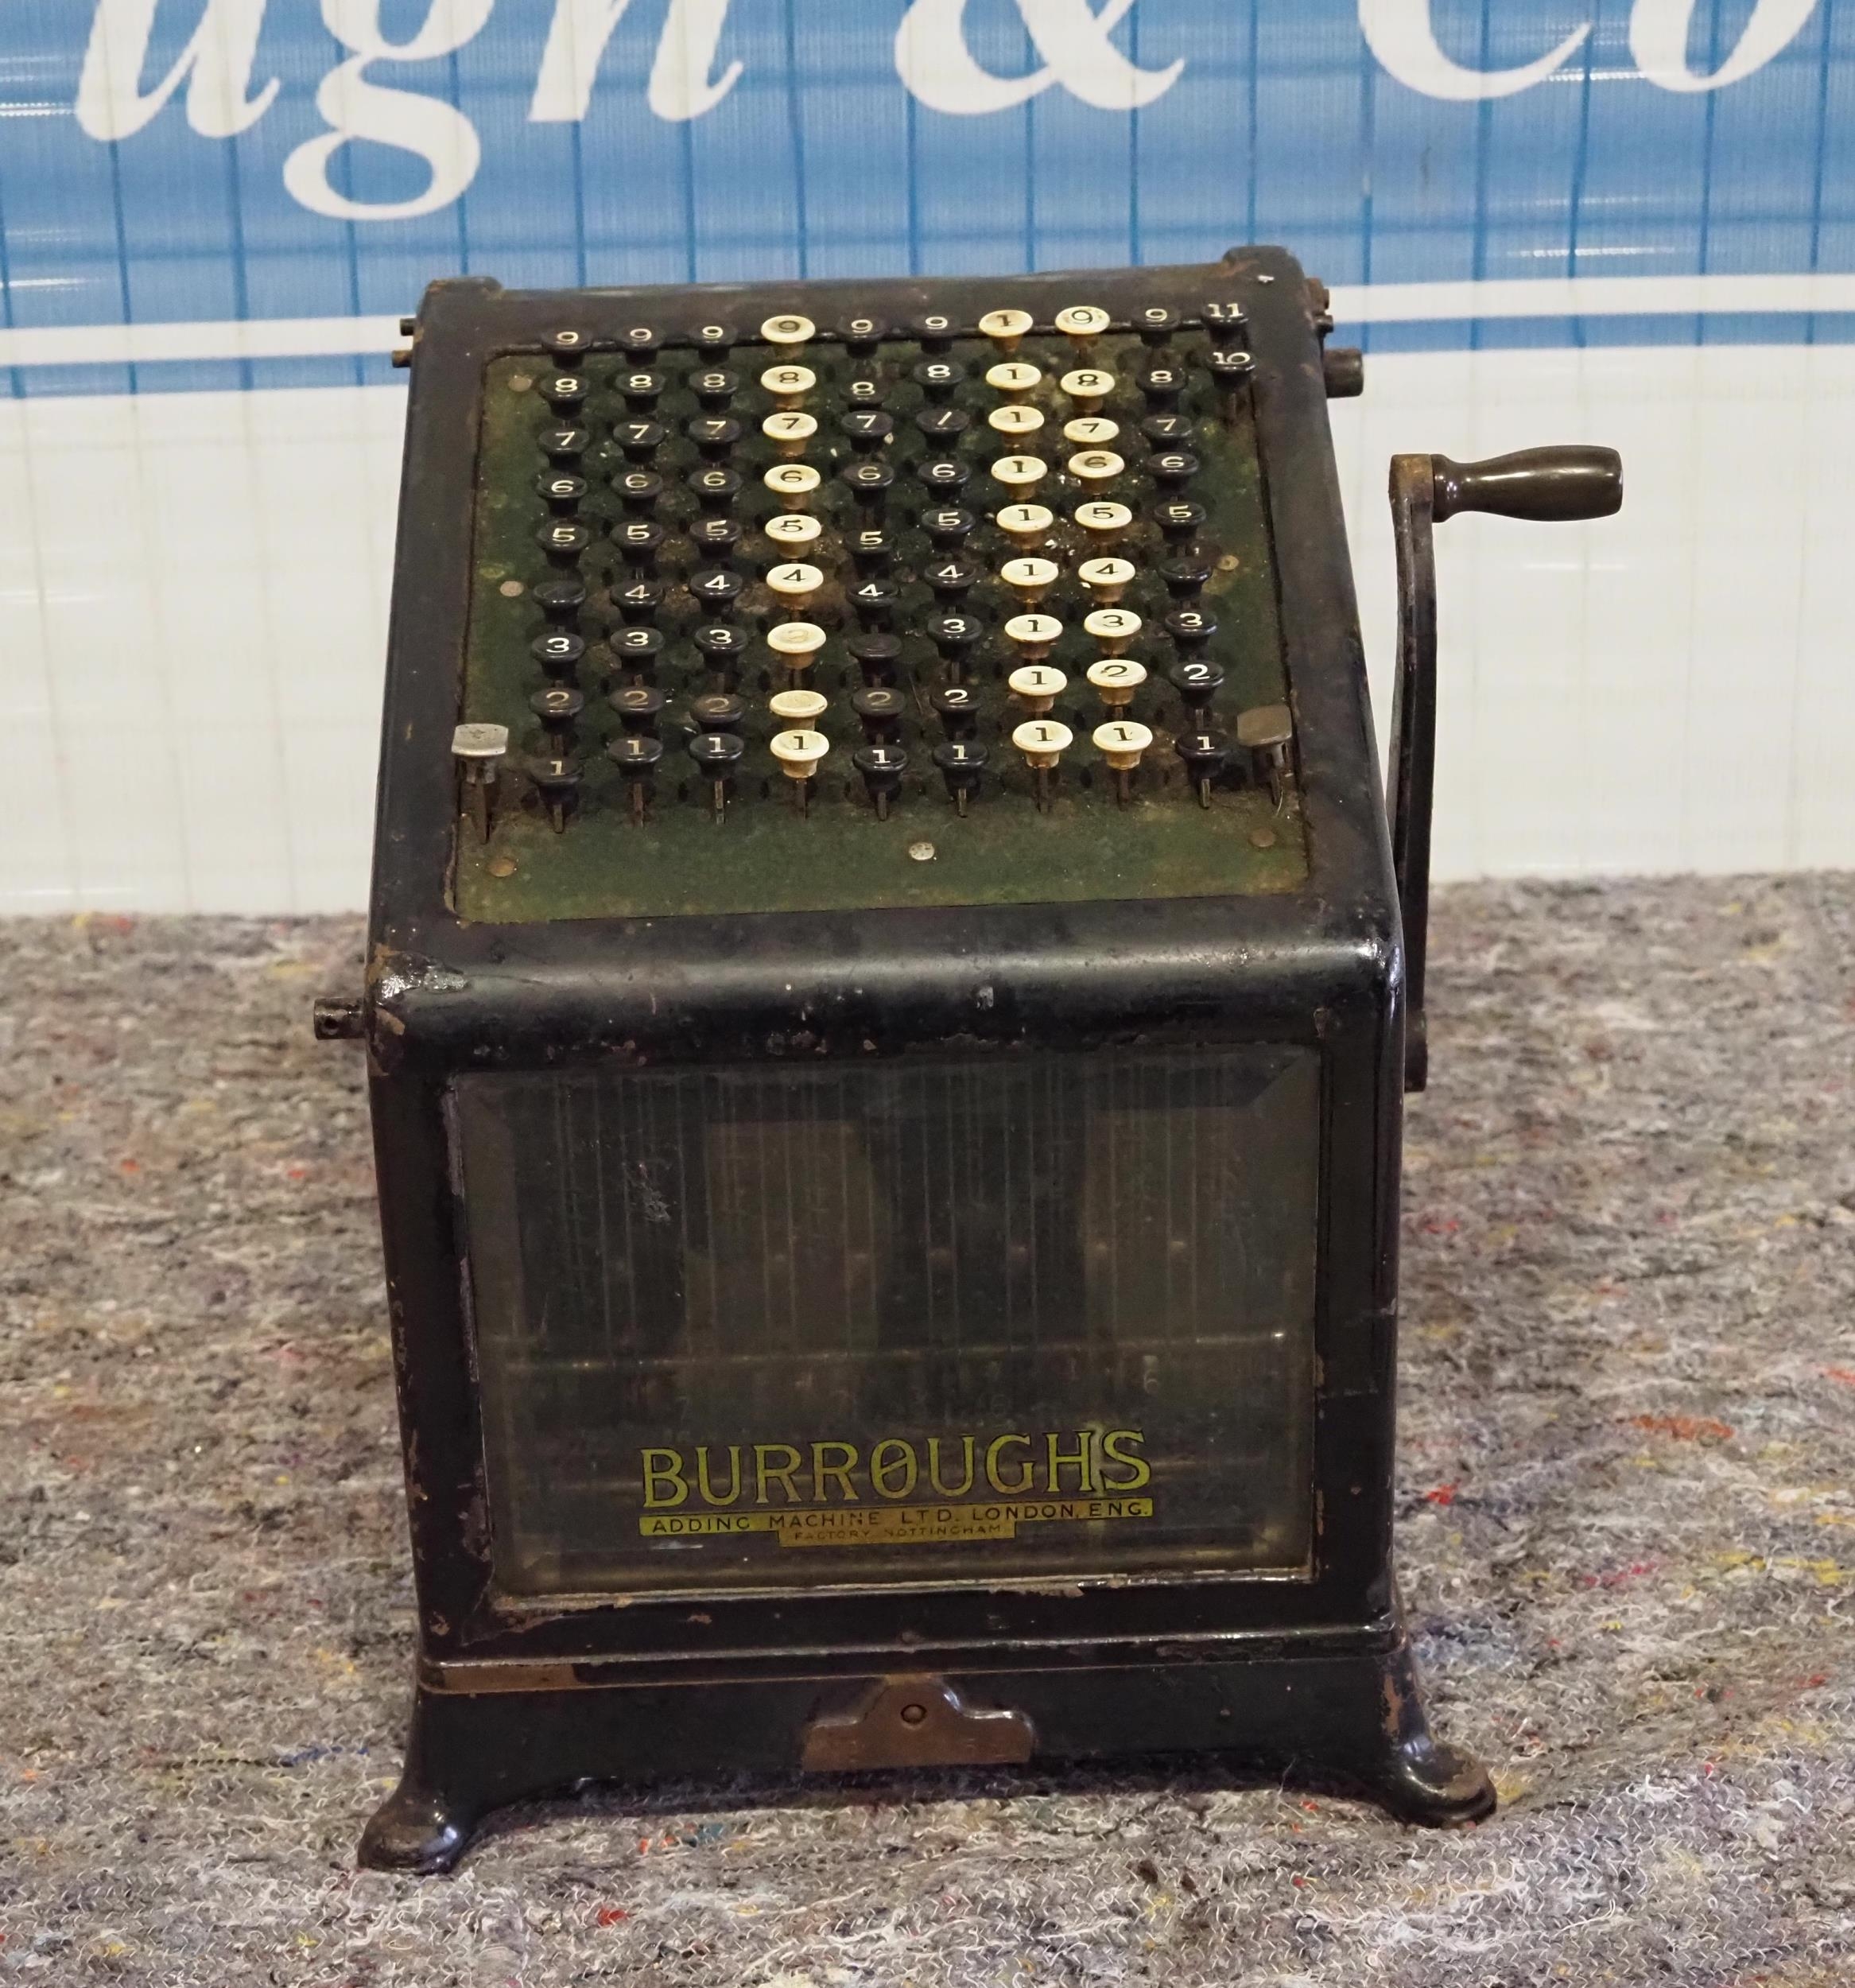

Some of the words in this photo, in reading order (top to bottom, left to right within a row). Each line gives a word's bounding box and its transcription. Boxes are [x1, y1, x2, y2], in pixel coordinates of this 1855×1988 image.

[557, 331, 579, 344] 9
[629, 328, 653, 342] 9
[701, 325, 724, 340] 9
[850, 318, 874, 333] 9
[925, 316, 949, 330] 9
[995, 313, 1012, 327] 1
[1071, 309, 1093, 325] 9
[1145, 308, 1168, 322] 9
[1206, 303, 1244, 318] 11
[555, 378, 578, 393] 8
[629, 374, 653, 388] 8
[703, 373, 726, 388] 8
[778, 371, 800, 385] 8
[852, 381, 875, 396] 8
[926, 364, 951, 379] 8
[1006, 367, 1019, 380] 1
[1077, 373, 1099, 387] 8
[1150, 369, 1173, 384] 8
[1212, 351, 1251, 365] 10
[555, 431, 576, 446] 7
[629, 424, 650, 439] 7
[706, 420, 727, 435] 7
[782, 417, 801, 430] 7
[856, 414, 877, 429] 7
[1009, 411, 1024, 423] 1
[1081, 422, 1100, 433] 7
[1156, 417, 1177, 432] 7
[551, 480, 575, 493] 6
[625, 473, 650, 489] 6
[703, 471, 726, 487] 6
[779, 469, 803, 483] 6
[857, 466, 882, 481] 6
[932, 463, 956, 478] 6
[1011, 460, 1027, 474] 1
[1084, 456, 1108, 469] 6
[1160, 456, 1185, 468] 6
[552, 527, 576, 542] 5
[627, 524, 650, 540] 5
[706, 519, 728, 537] 5
[779, 518, 803, 534] 5
[859, 530, 883, 546] 5
[937, 511, 961, 526] 5
[1017, 508, 1035, 522] 1
[1092, 507, 1114, 520] 5
[1168, 504, 1193, 519] 5
[624, 584, 650, 600] 4
[704, 574, 731, 591] 4
[782, 569, 806, 582] 4
[858, 583, 884, 597] 4
[937, 564, 964, 579] 4
[1023, 563, 1038, 577] 1
[1095, 562, 1119, 576] 4
[545, 637, 570, 654] 3
[625, 631, 649, 646] 3
[709, 629, 732, 645] 3
[942, 618, 966, 634] 3
[1026, 619, 1042, 633] 1
[1102, 614, 1124, 628] 3
[1178, 612, 1204, 628] 3
[545, 691, 570, 708] 2
[623, 690, 649, 706] 2
[704, 697, 730, 712] 2
[867, 691, 891, 706] 2
[944, 689, 969, 704] 2
[1030, 670, 1048, 685] 1
[1099, 664, 1130, 678] 2
[1183, 663, 1210, 681] 2
[549, 760, 564, 776] 1
[626, 739, 645, 755] 1
[708, 736, 726, 753] 1
[793, 735, 809, 751] 1
[871, 749, 891, 764] 1
[952, 744, 969, 760] 1
[1034, 726, 1054, 742] 1
[1112, 727, 1134, 742] 1
[1196, 735, 1216, 751] 1
[640, 1430, 1151, 1508] BURROUGHS
[652, 1516, 751, 1534] ADDING
[768, 1511, 880, 1529] MACHINE
[901, 1508, 960, 1525] LTD.
[1089, 1501, 1149, 1518] ENG.
[794, 1529, 871, 1541] FACTORY
